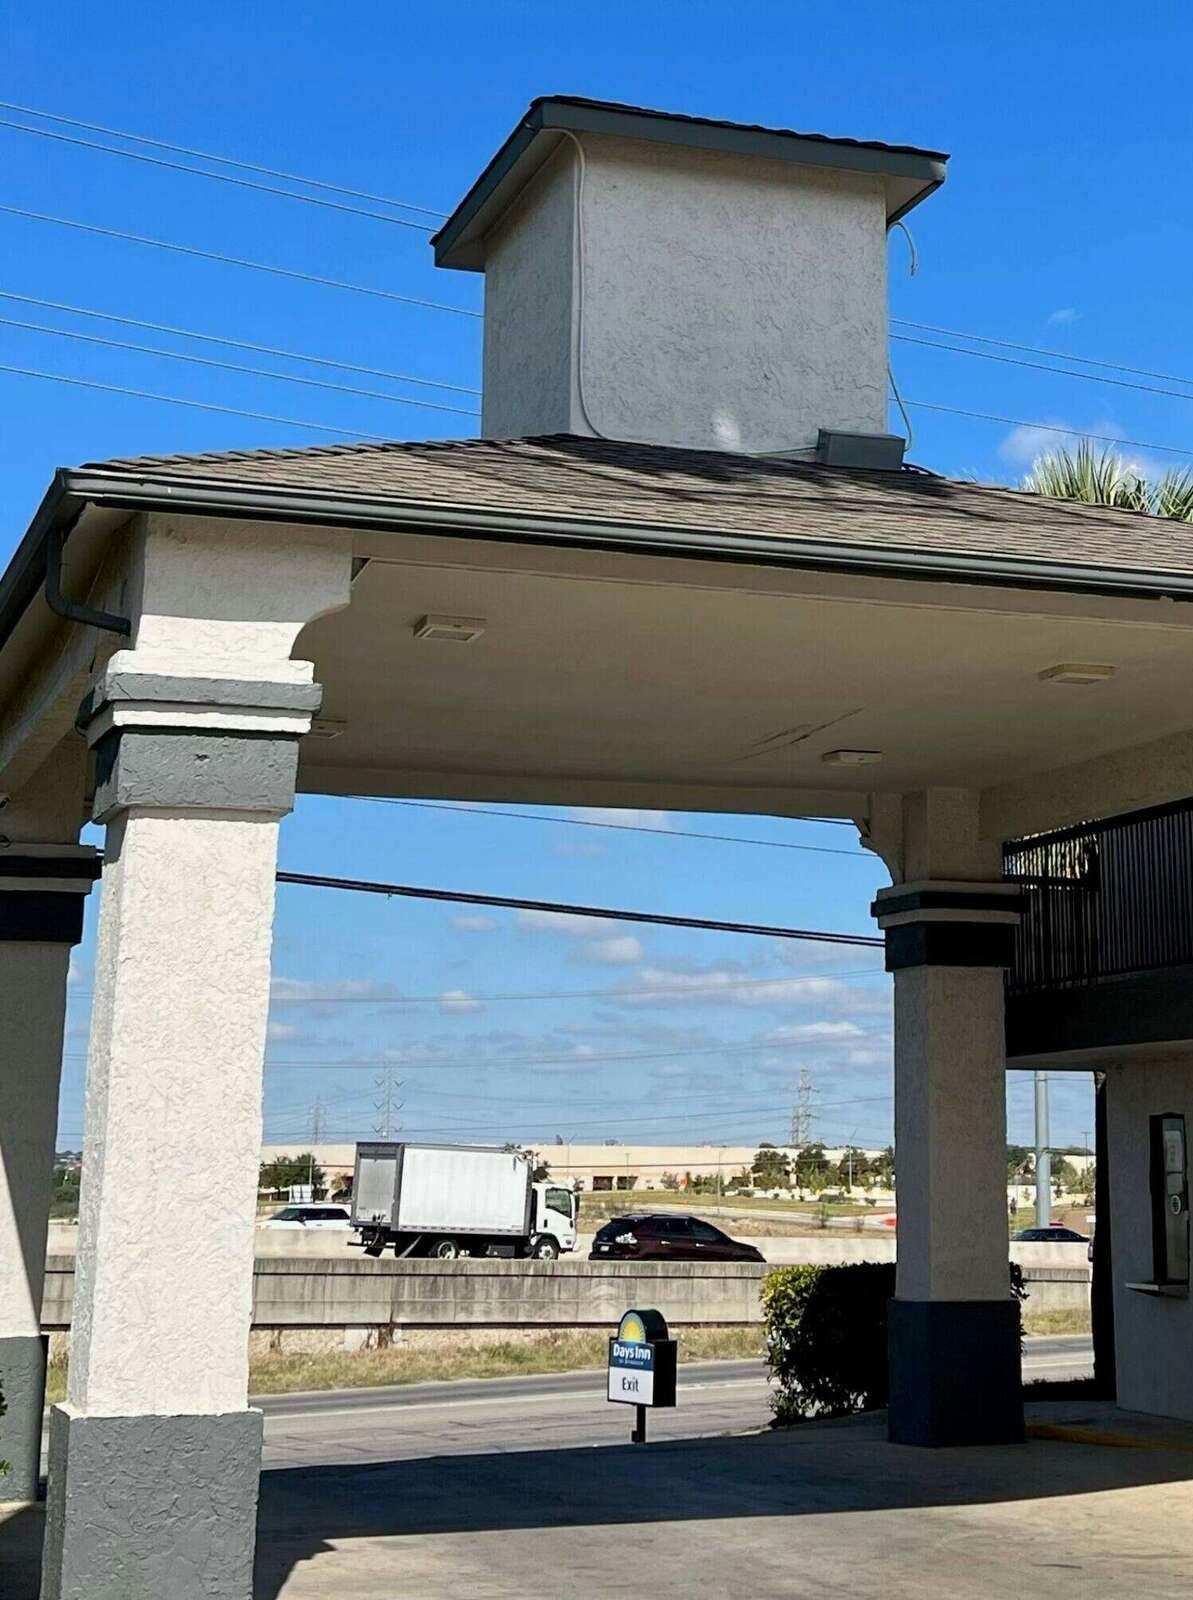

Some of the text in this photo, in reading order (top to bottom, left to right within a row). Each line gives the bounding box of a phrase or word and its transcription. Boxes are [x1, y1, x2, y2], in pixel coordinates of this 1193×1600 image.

[613, 1343, 651, 1360] Days Inn
[622, 1376, 639, 1392] Exit
